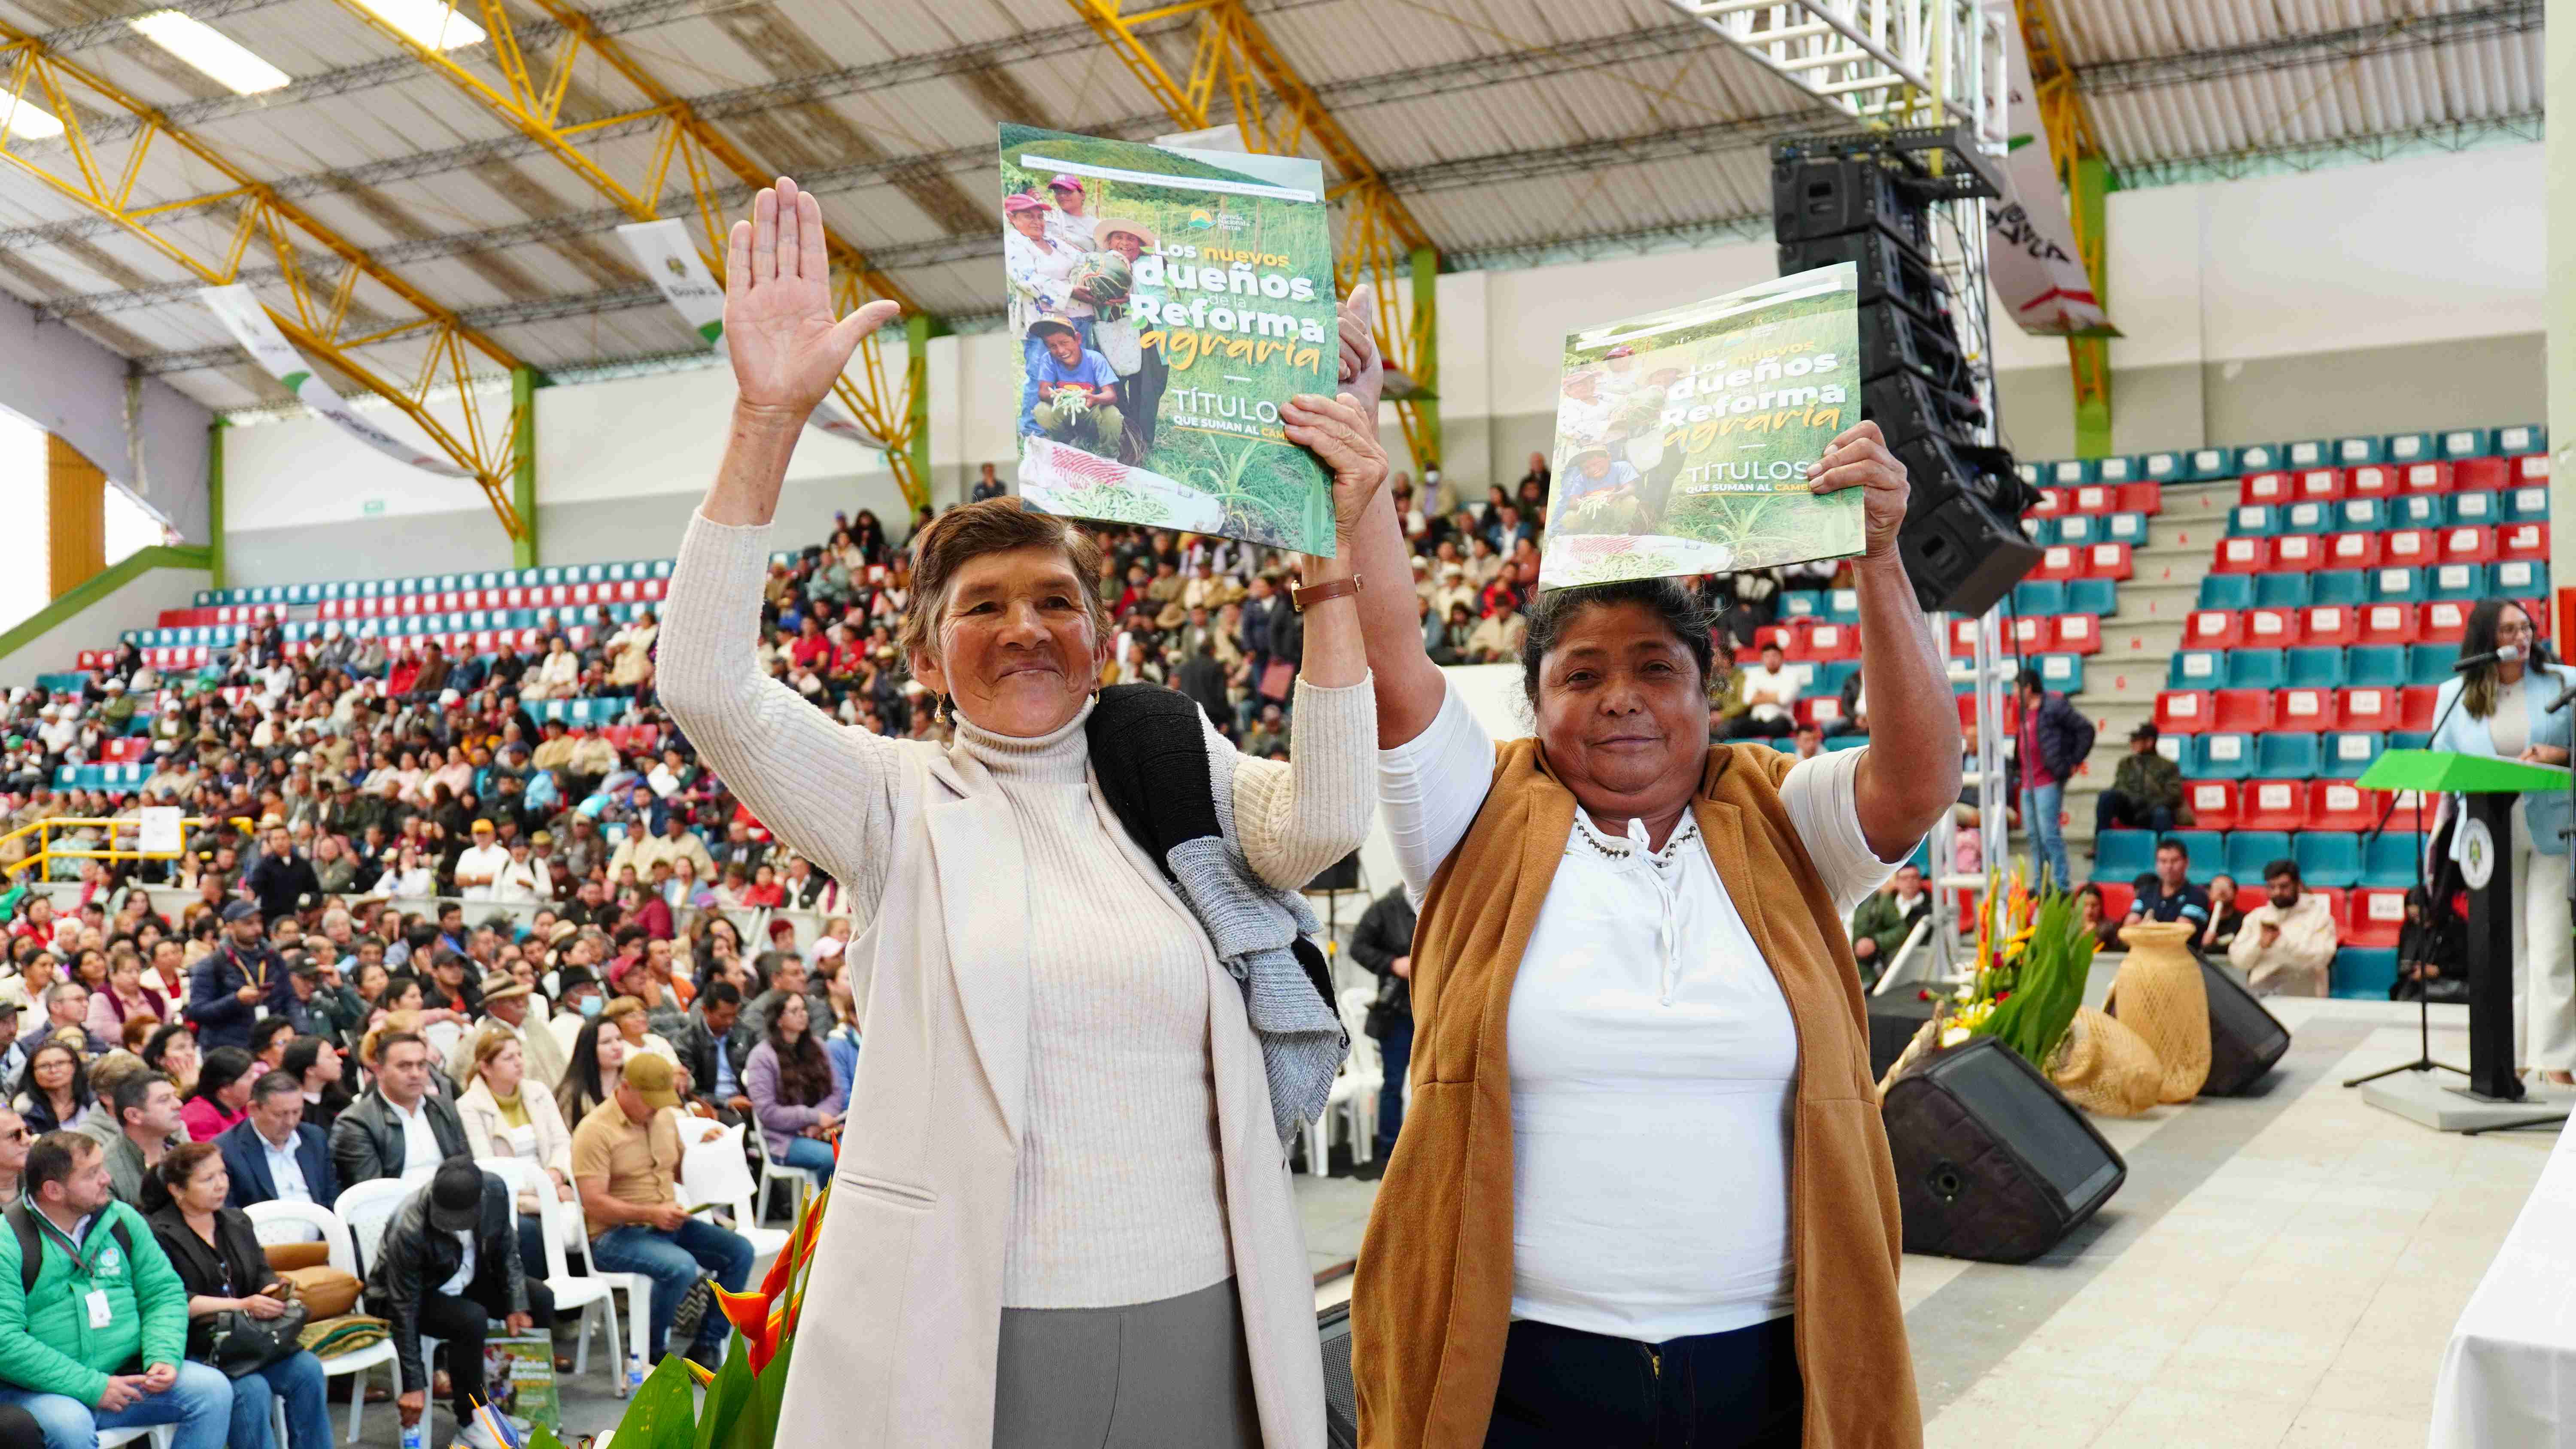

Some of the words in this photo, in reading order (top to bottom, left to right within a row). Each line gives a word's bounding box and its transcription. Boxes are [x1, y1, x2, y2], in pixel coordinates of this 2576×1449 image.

[1154, 240, 1197, 258] Los
[1203, 247, 1290, 268] nuevos
[1132, 255, 1315, 302] dueños
[1130, 293, 1326, 343] Reforma
[1209, 293, 1230, 306] de
[1234, 295, 1246, 307] la
[1140, 330, 1321, 375] agraria
[1690, 359, 1728, 376] Los
[1736, 340, 1814, 365] nuevos
[1668, 353, 1838, 401] dueños
[1171, 387, 1286, 425] TÍTULO
[1660, 383, 1846, 427] Reforma
[1174, 415, 1199, 427] QUE
[1202, 418, 1242, 432] SUMAN
[1245, 424, 1260, 436] AL
[1261, 427, 1288, 440] CAM
[1663, 406, 1841, 454] agraria
[1685, 484, 1710, 494] QUE
[1756, 483, 1772, 491] AL
[1686, 461, 1810, 482] TÍTULOS
